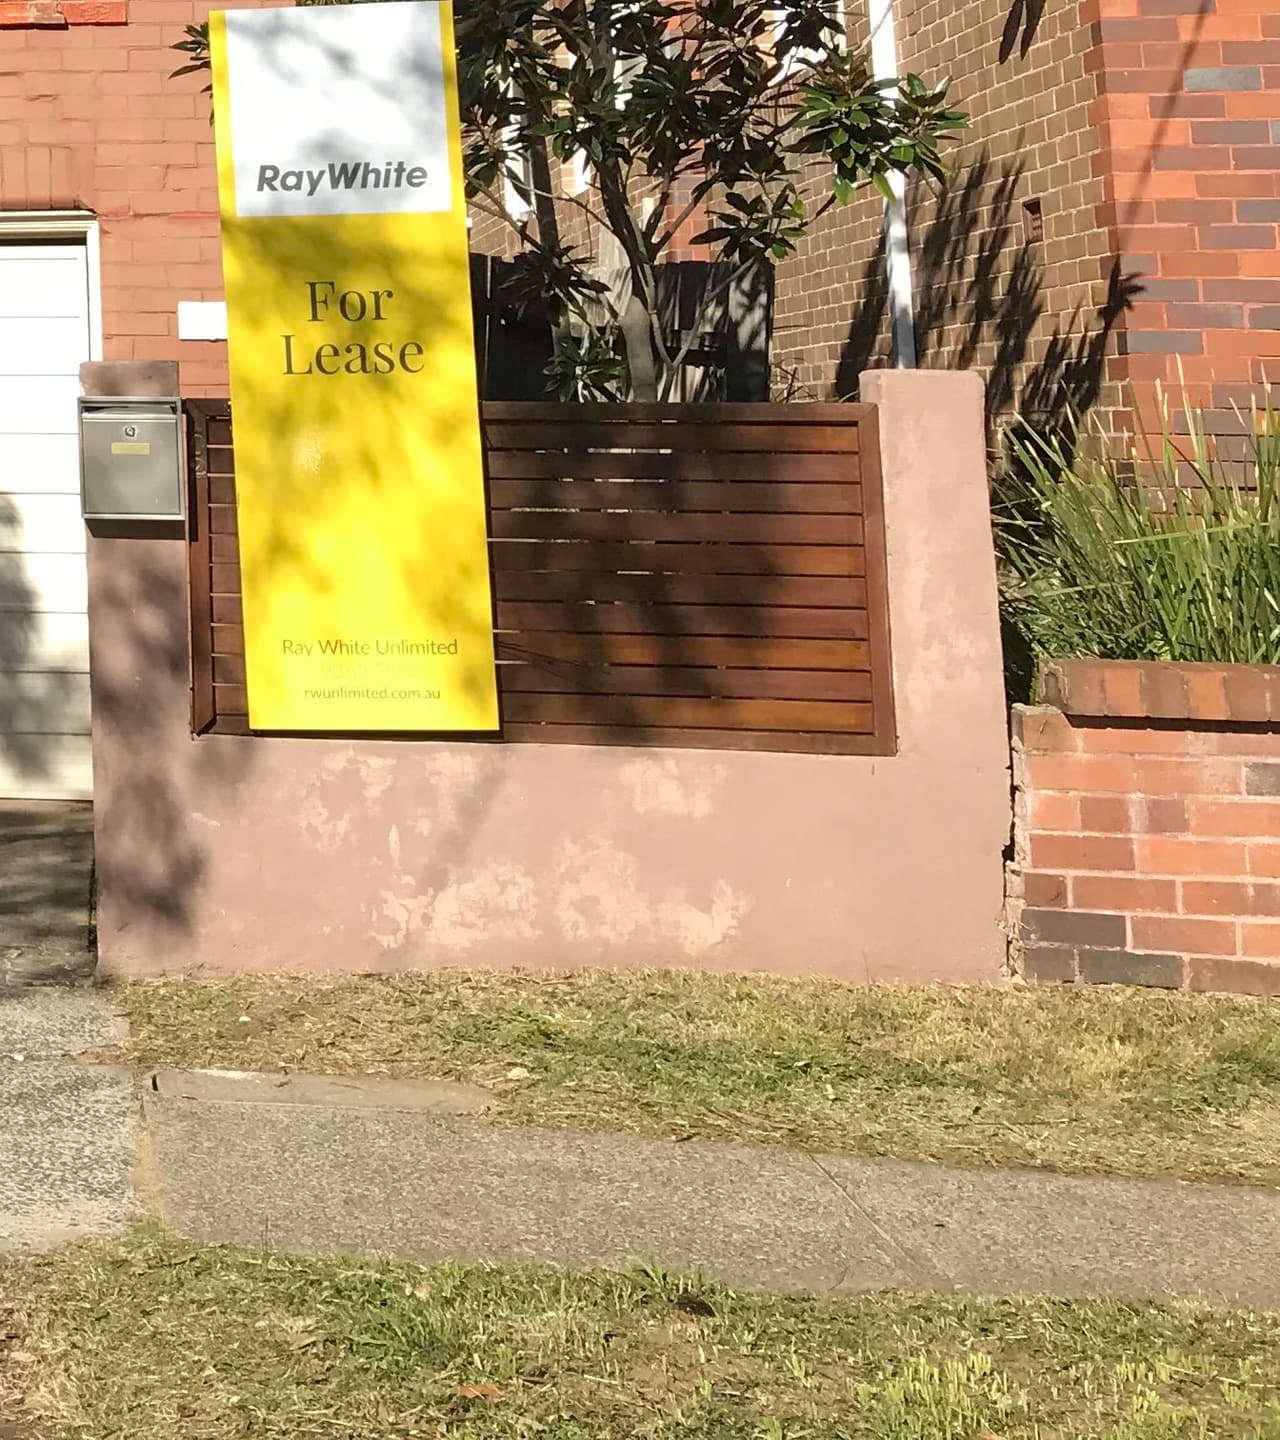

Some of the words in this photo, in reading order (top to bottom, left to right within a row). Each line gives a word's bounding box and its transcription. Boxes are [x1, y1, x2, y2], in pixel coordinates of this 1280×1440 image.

[305, 281, 394, 322] For
[280, 335, 425, 375] Lease
[282, 639, 313, 657] Ray
[318, 639, 371, 656] White
[376, 639, 458, 656] Unlimited
[303, 686, 441, 700] rwunlimited.com.au
